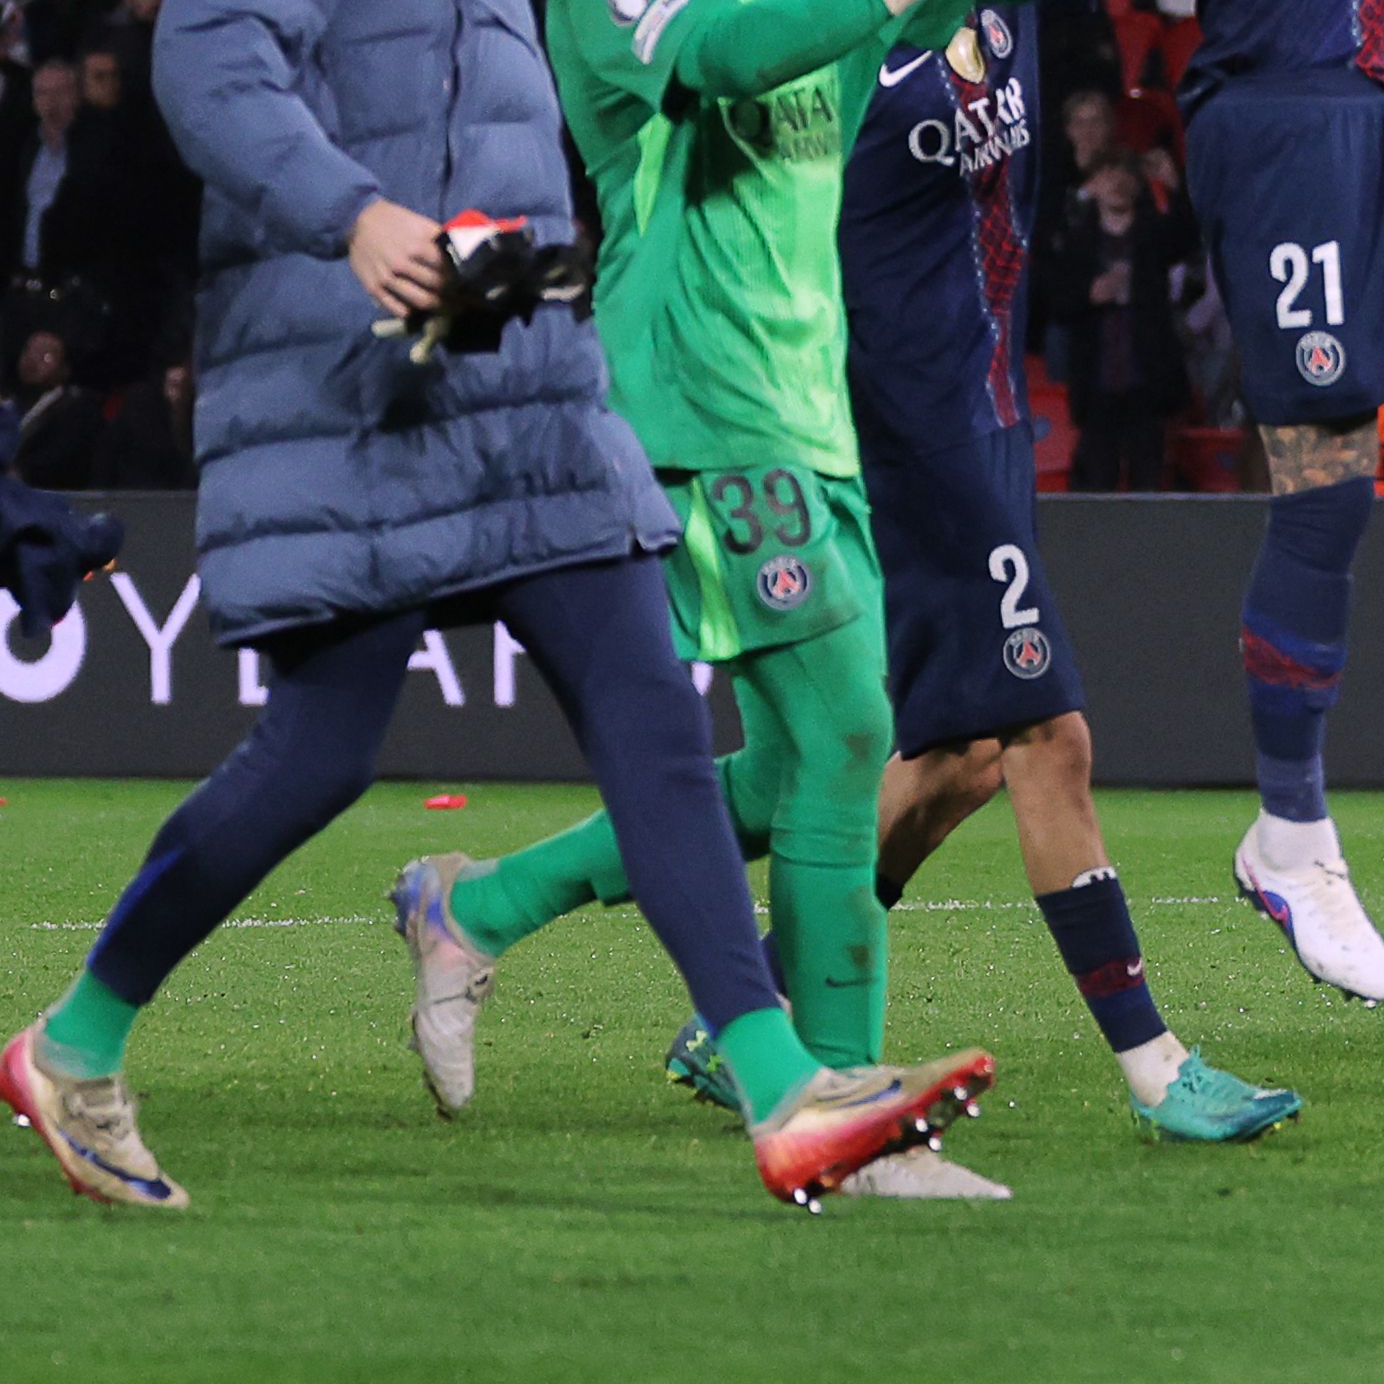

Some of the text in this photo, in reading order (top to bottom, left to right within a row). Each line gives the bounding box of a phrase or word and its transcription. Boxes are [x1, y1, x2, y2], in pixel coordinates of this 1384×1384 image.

[1269, 240, 1345, 330] 21
[712, 467, 812, 556] 39
[988, 543, 1040, 630] 2
